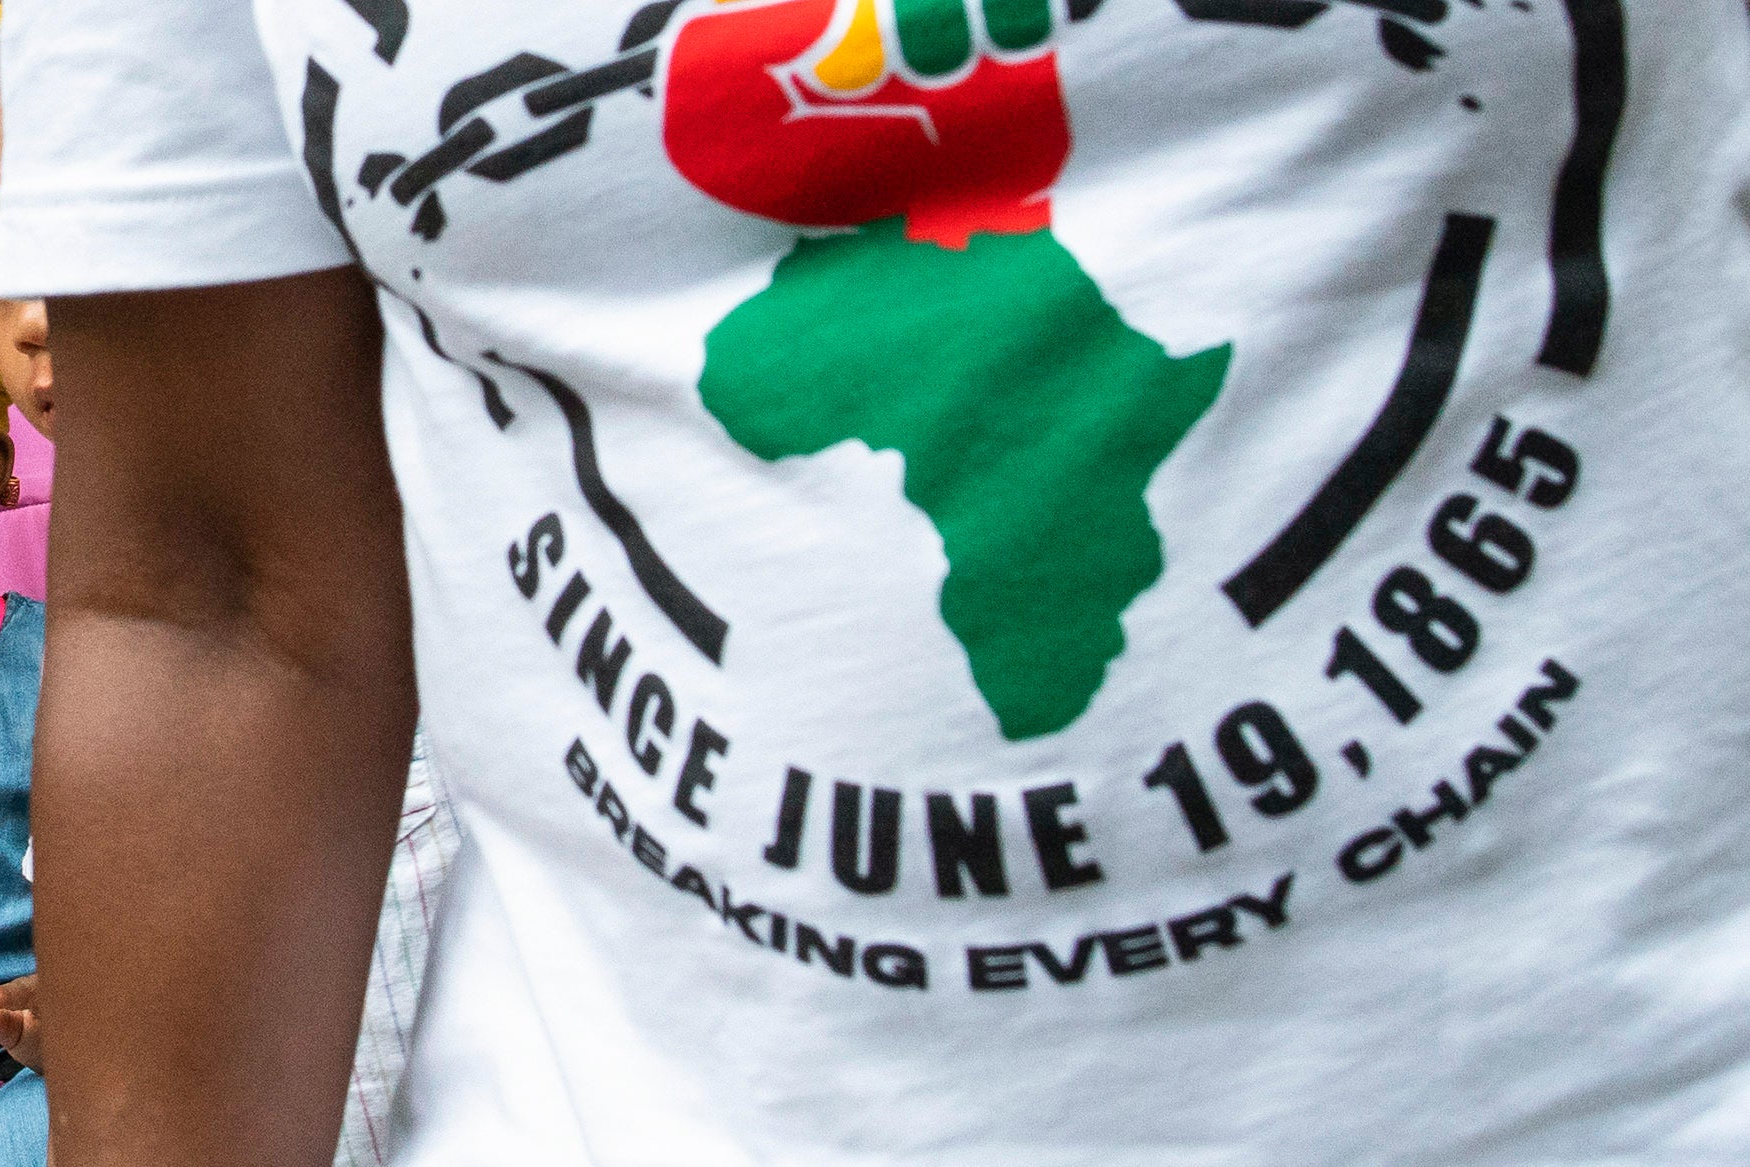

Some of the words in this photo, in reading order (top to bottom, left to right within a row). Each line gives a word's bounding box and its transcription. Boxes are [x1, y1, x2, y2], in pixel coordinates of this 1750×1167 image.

[508, 512, 730, 827] SINCE
[763, 765, 1105, 900] JUNE
[564, 737, 929, 990] BREAKING
[965, 873, 1296, 992] EVERY
[1335, 658, 1581, 883] CHAIN
